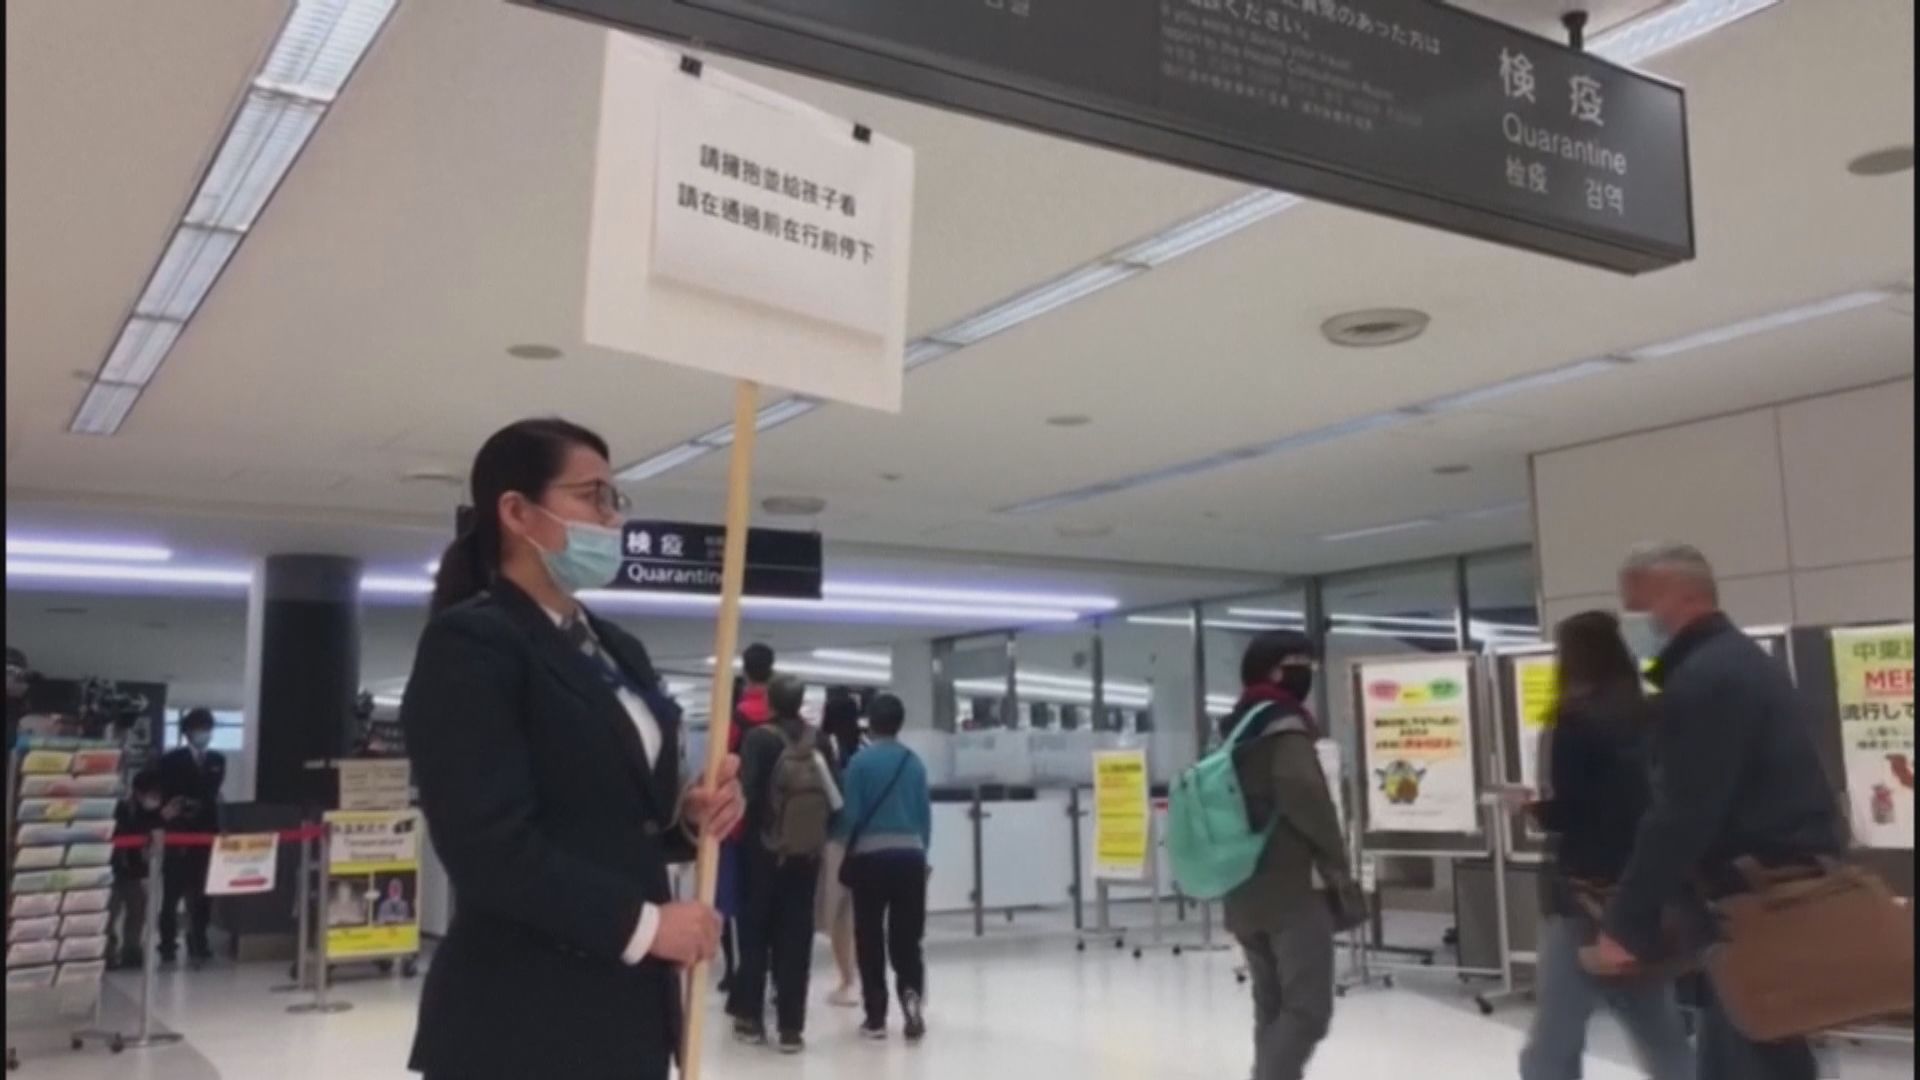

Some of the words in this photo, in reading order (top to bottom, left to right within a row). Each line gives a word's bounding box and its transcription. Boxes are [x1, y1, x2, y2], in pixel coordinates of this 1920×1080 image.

[1499, 46, 1605, 128] 検疫
[1502, 111, 1627, 176] Quarantine
[677, 181, 875, 265] 請在通過前在行前停下
[1585, 178, 1624, 216] 검역
[626, 562, 725, 584] Quarantin
